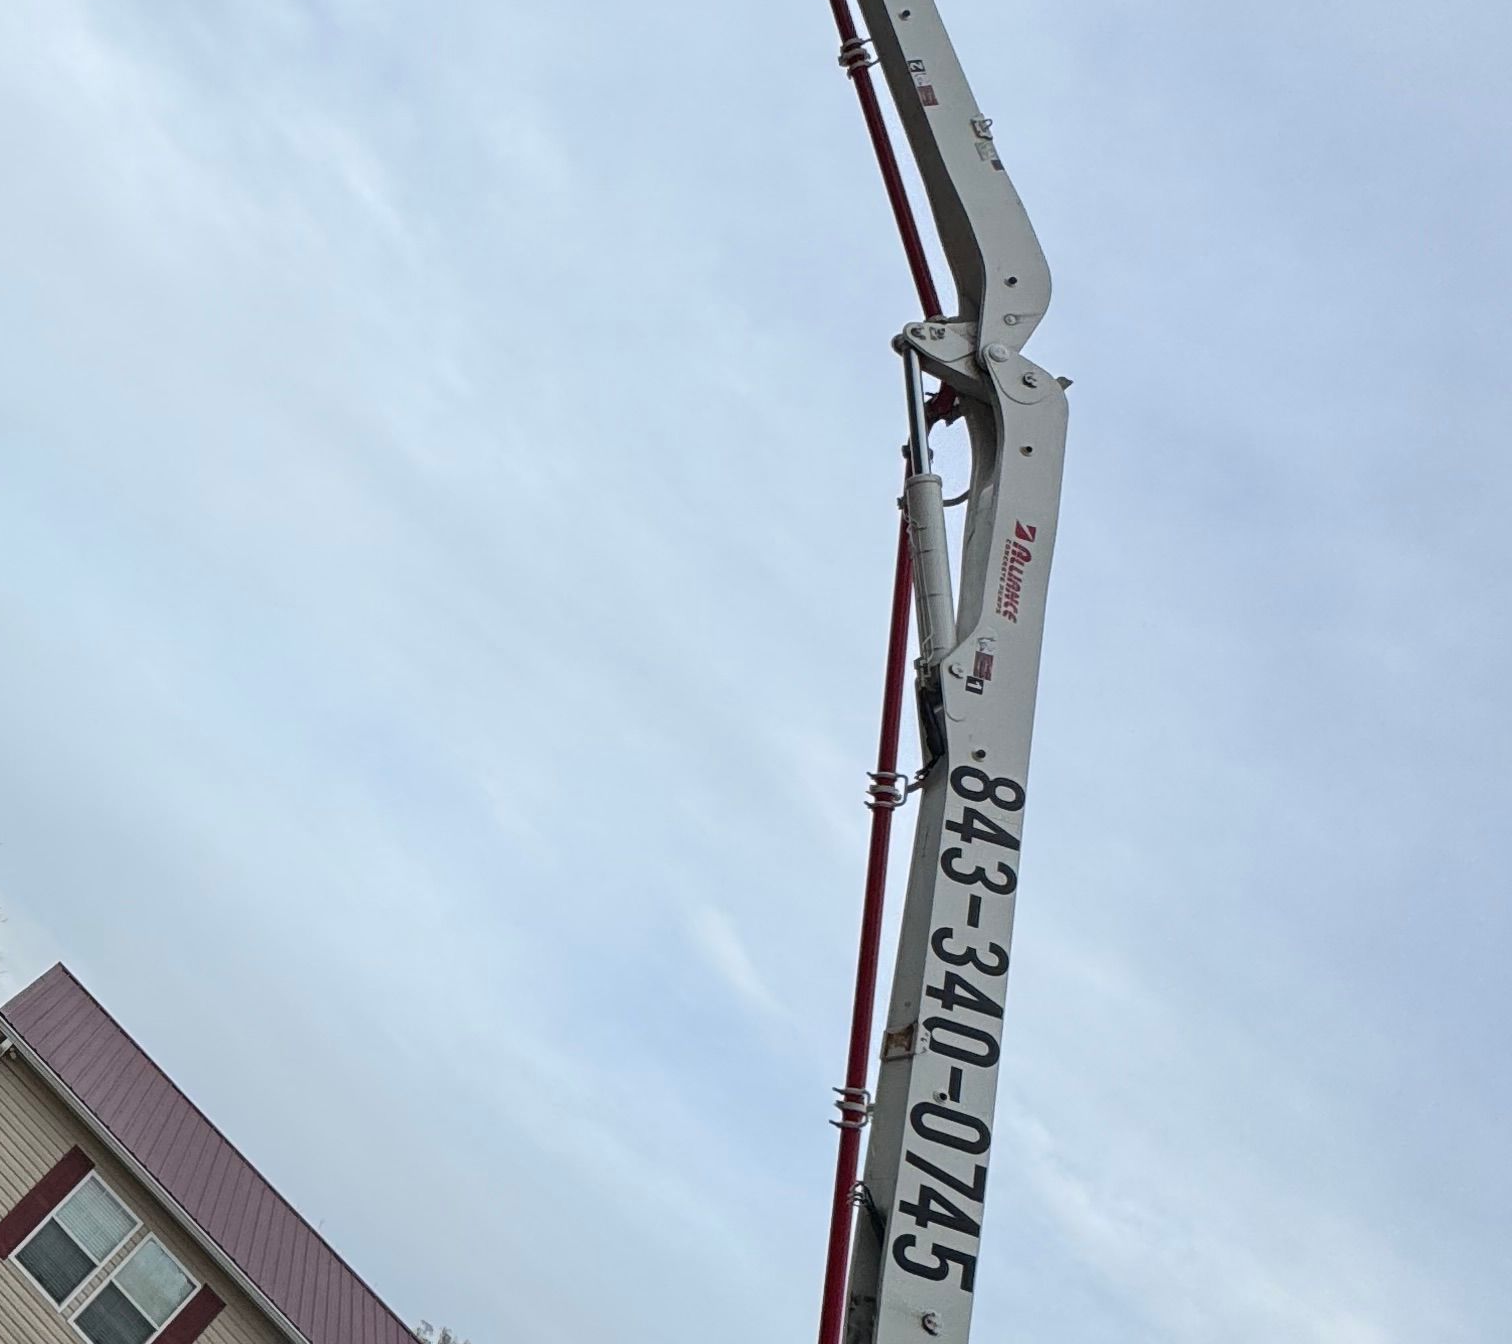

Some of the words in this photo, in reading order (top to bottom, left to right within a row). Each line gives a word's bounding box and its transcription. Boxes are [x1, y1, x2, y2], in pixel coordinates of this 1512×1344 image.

[909, 61, 924, 72] 2
[1000, 538, 1012, 582] CONCRETE
[1002, 541, 1032, 624] ALLIANCE
[891, 764, 1027, 1294] 843-340-0745
